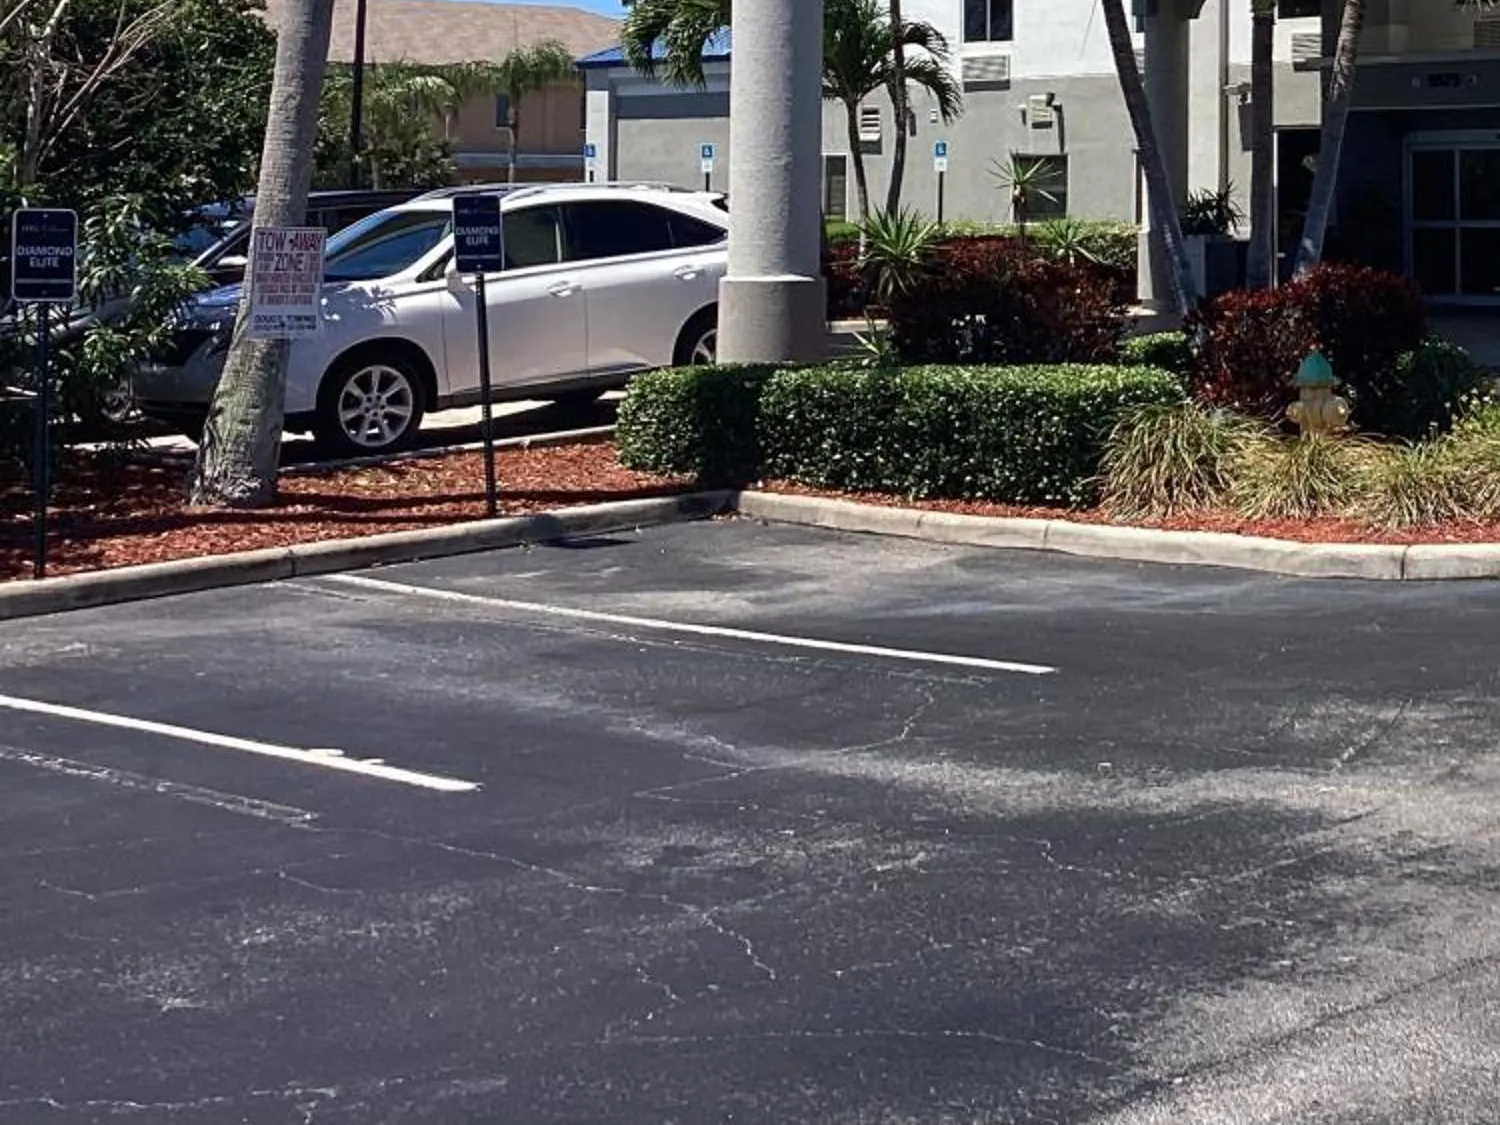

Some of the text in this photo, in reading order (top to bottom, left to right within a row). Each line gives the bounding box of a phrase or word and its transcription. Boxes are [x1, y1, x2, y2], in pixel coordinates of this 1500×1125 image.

[18, 246, 73, 256] DIAMOND
[29, 257, 60, 268] ELITE
[274, 252, 305, 271] ZONE
